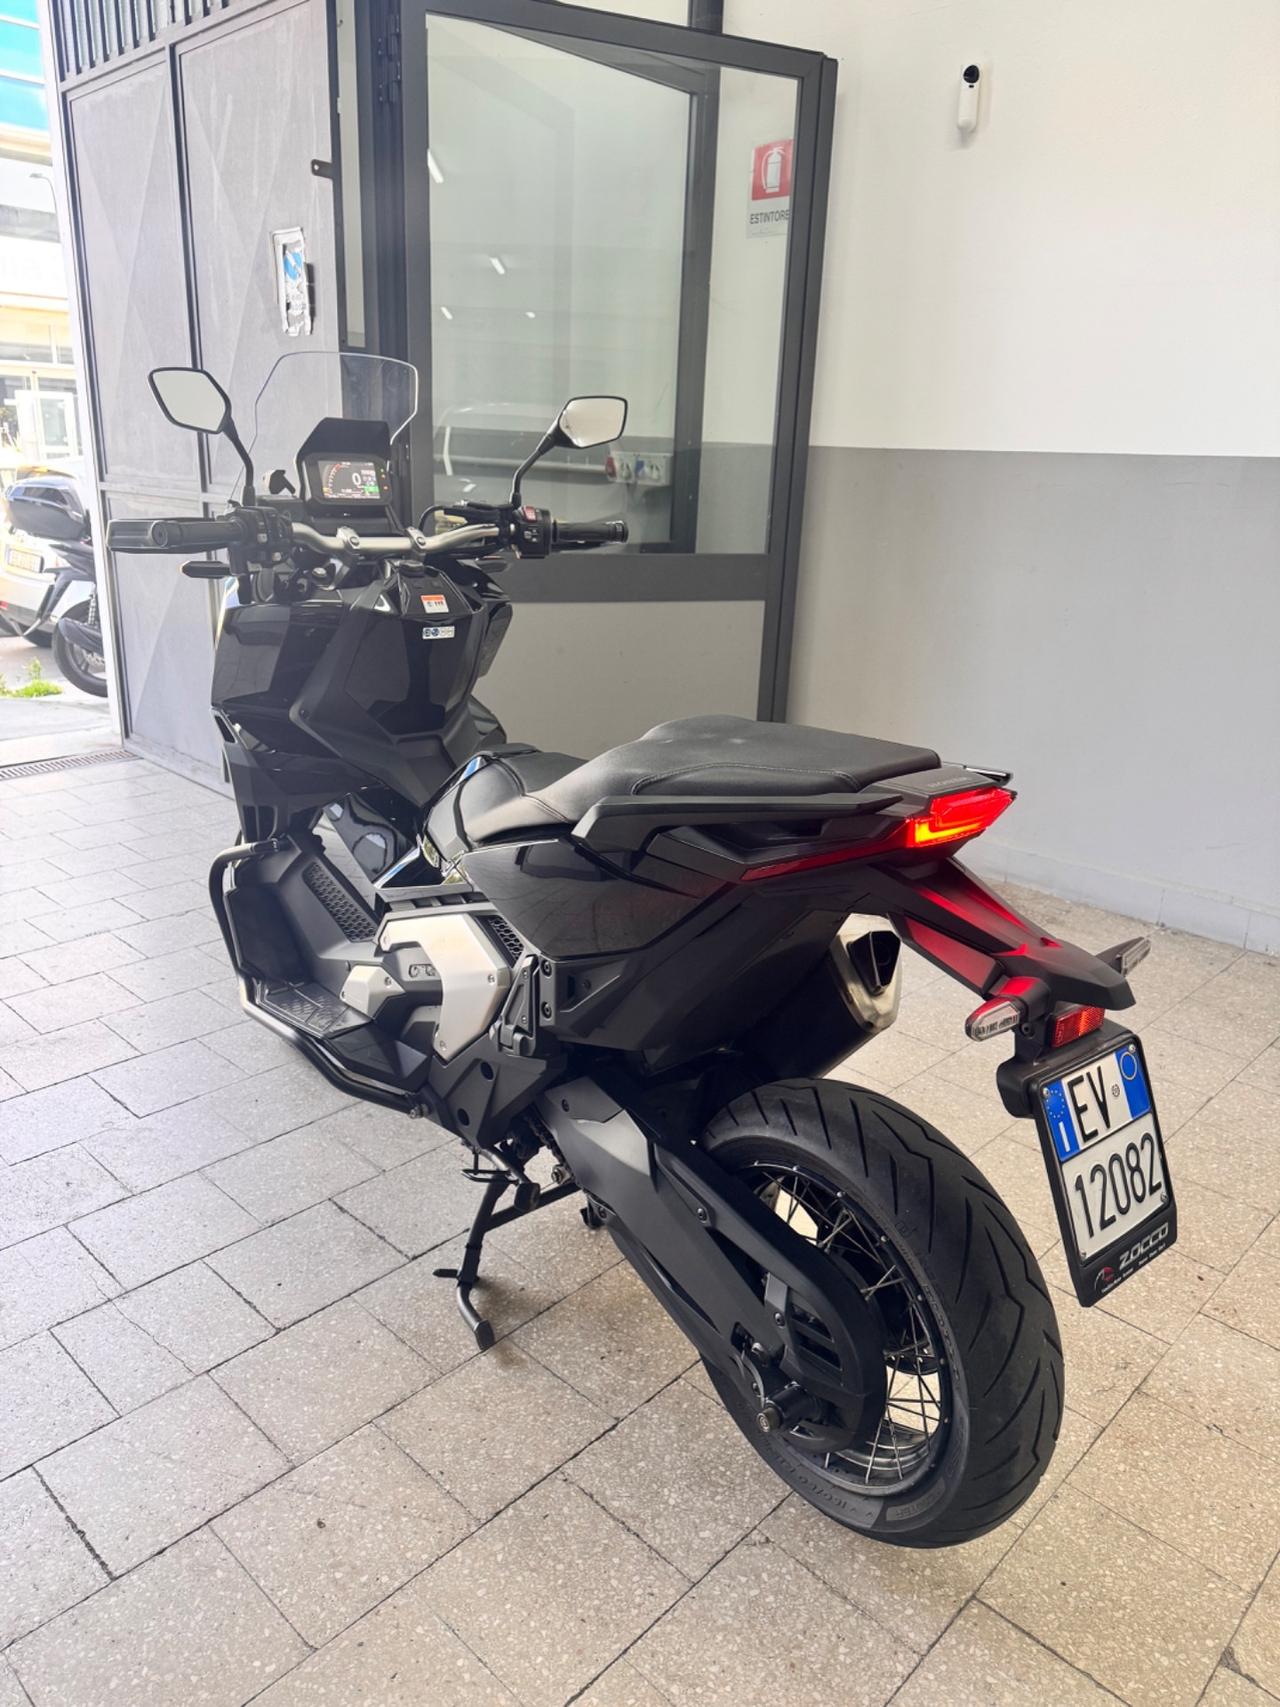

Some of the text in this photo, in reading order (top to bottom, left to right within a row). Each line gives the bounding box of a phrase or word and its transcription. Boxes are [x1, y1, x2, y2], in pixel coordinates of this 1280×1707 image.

[750, 209, 790, 224] ESTINTORE
[1067, 1065, 1111, 1142] EV
[1074, 1132, 1162, 1238] 12082
[1119, 1222, 1169, 1268] ZOCCO
